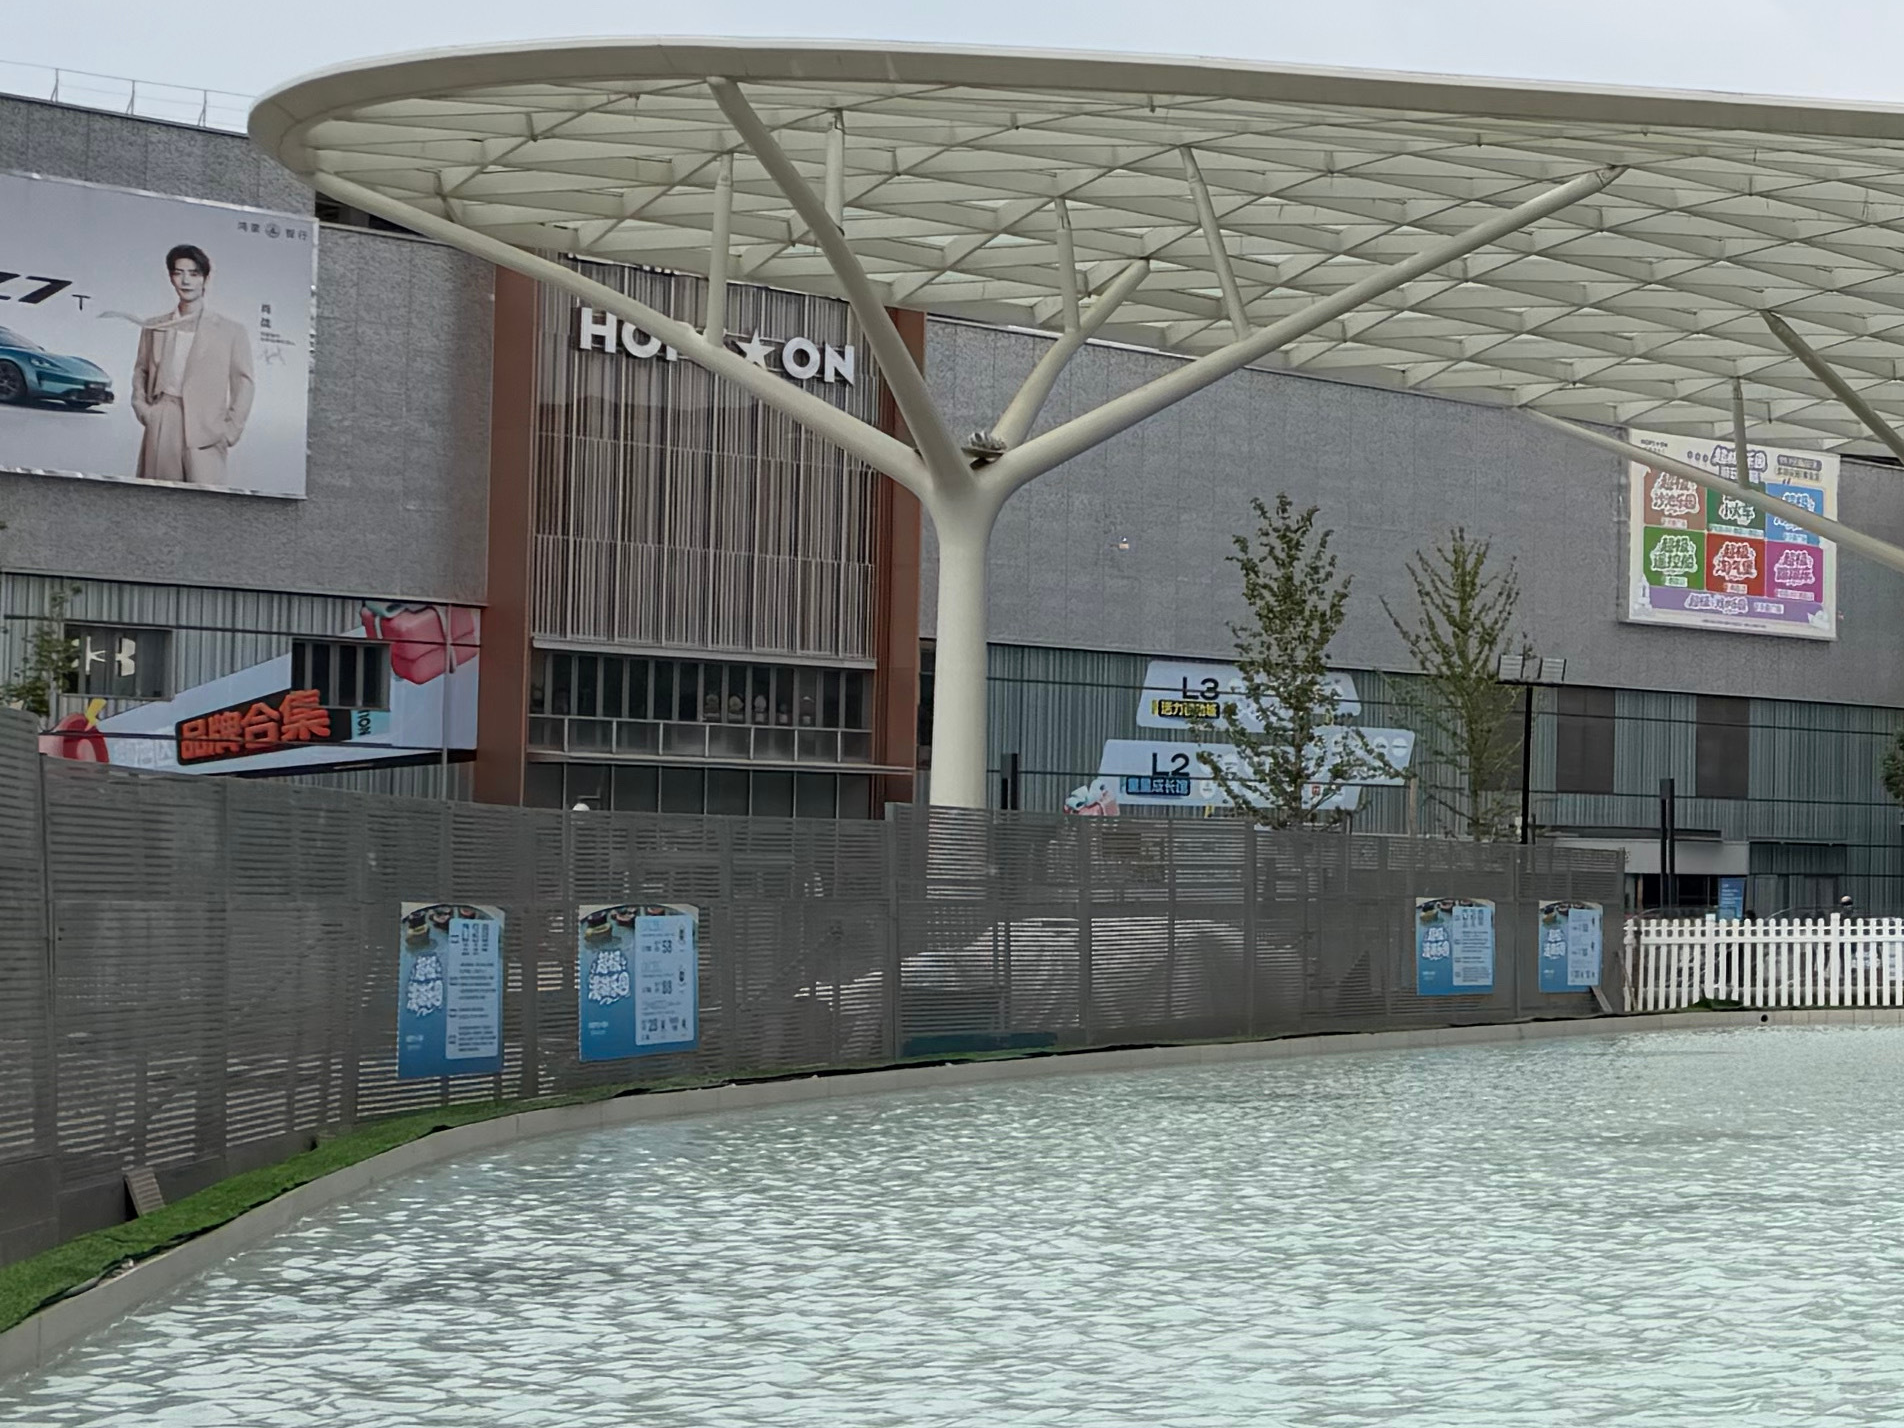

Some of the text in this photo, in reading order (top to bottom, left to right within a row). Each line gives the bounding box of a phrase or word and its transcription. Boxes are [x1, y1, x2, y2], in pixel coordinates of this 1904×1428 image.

[1182, 676, 1220, 700] L3
[179, 689, 332, 761] 品牌合集
[1151, 753, 1190, 776] L2
